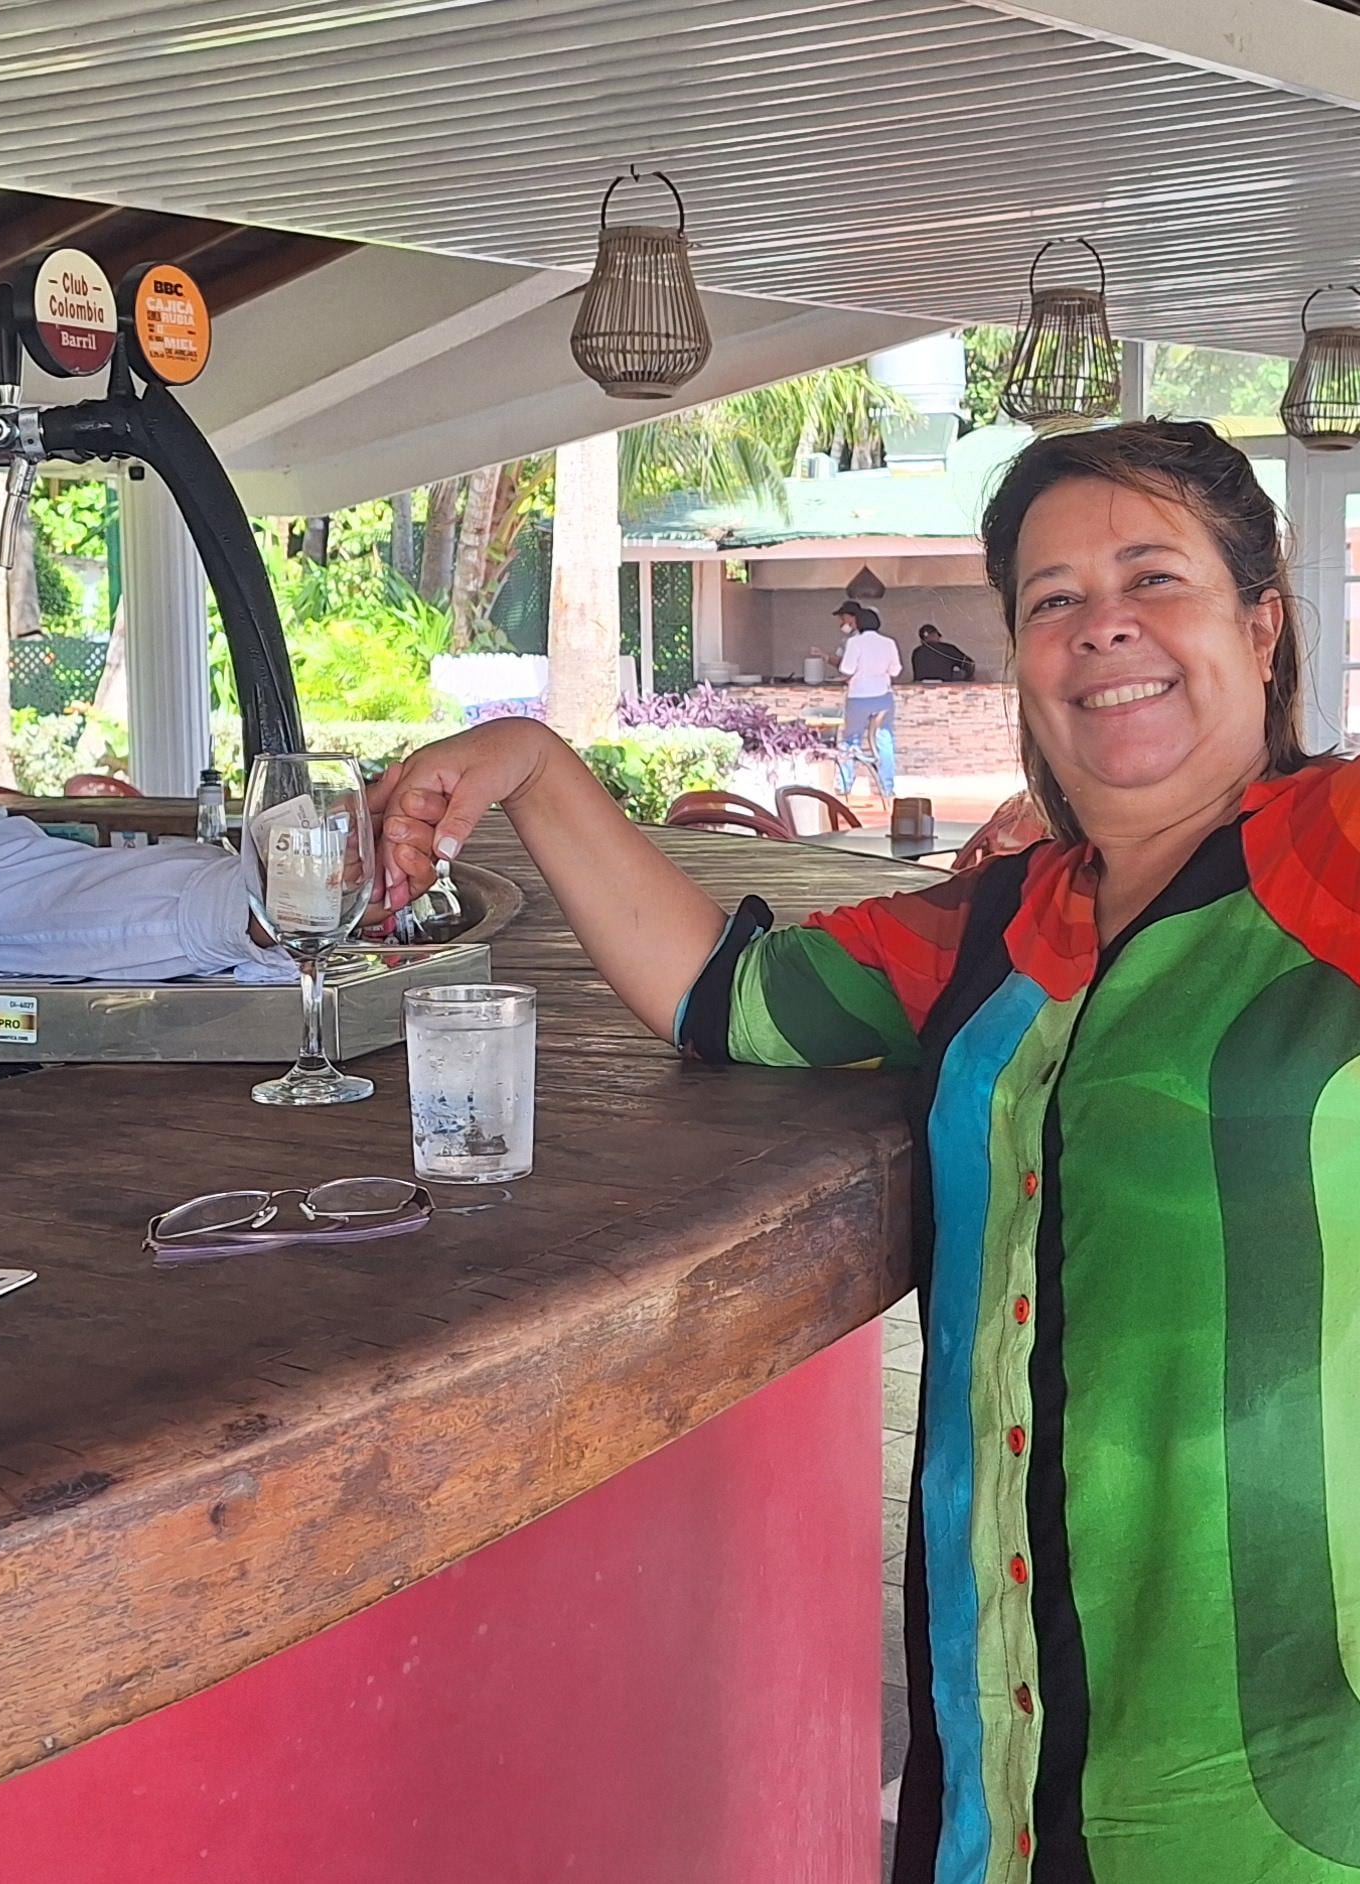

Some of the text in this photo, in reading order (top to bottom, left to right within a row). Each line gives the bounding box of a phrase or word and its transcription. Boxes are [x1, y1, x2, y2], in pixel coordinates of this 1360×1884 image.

[62, 272, 88, 297] Club
[154, 280, 184, 297] BBC
[49, 294, 104, 323] Colombia
[60, 331, 97, 350] Barril
